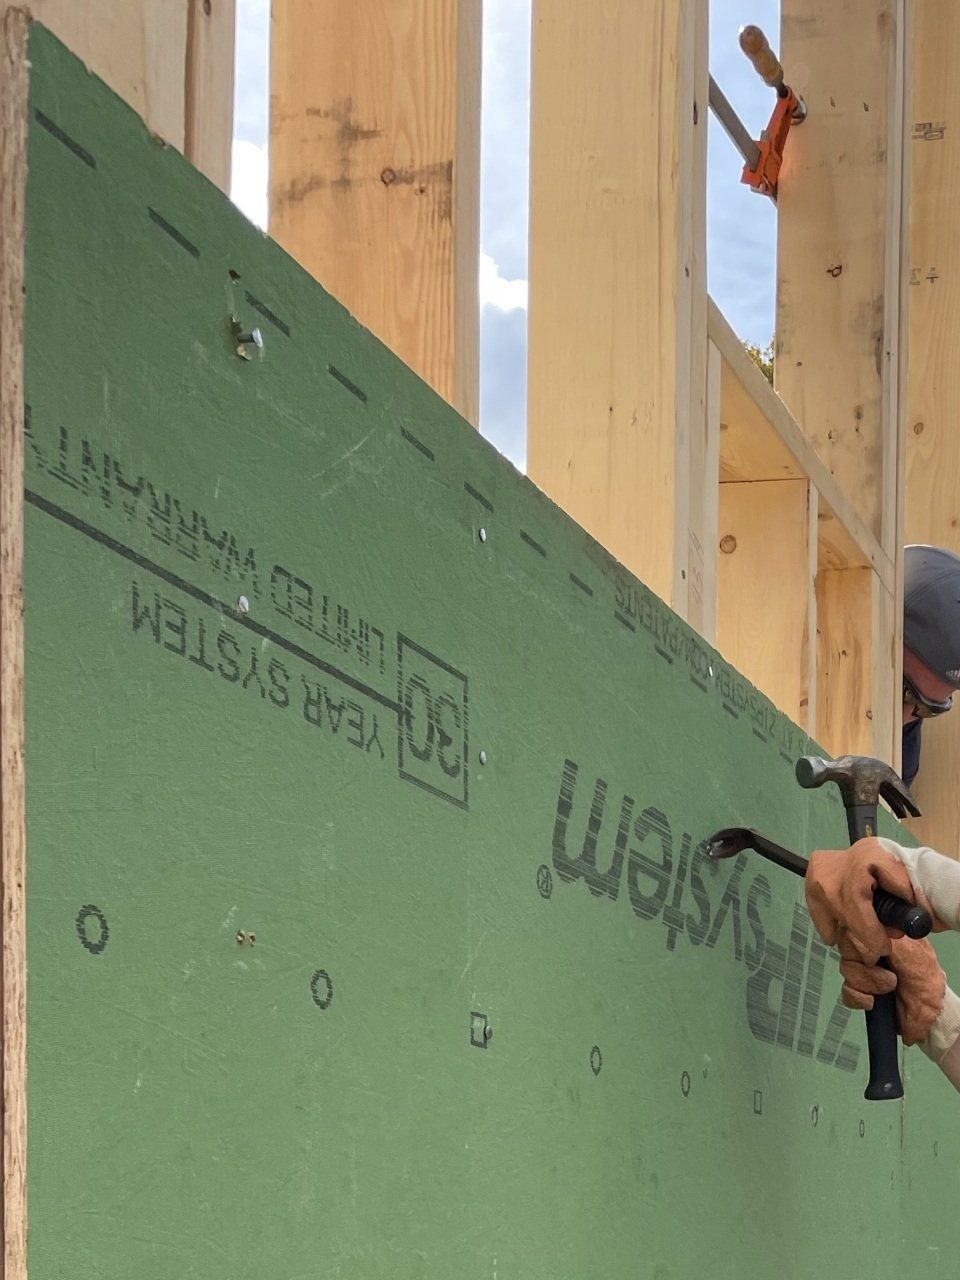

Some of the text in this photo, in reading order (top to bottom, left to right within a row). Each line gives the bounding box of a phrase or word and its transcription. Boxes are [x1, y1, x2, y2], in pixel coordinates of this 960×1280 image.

[131, 580, 385, 760] YEAR SYSTEM
[271, 564, 386, 675] LIMITED
[402, 672, 462, 778] 30
